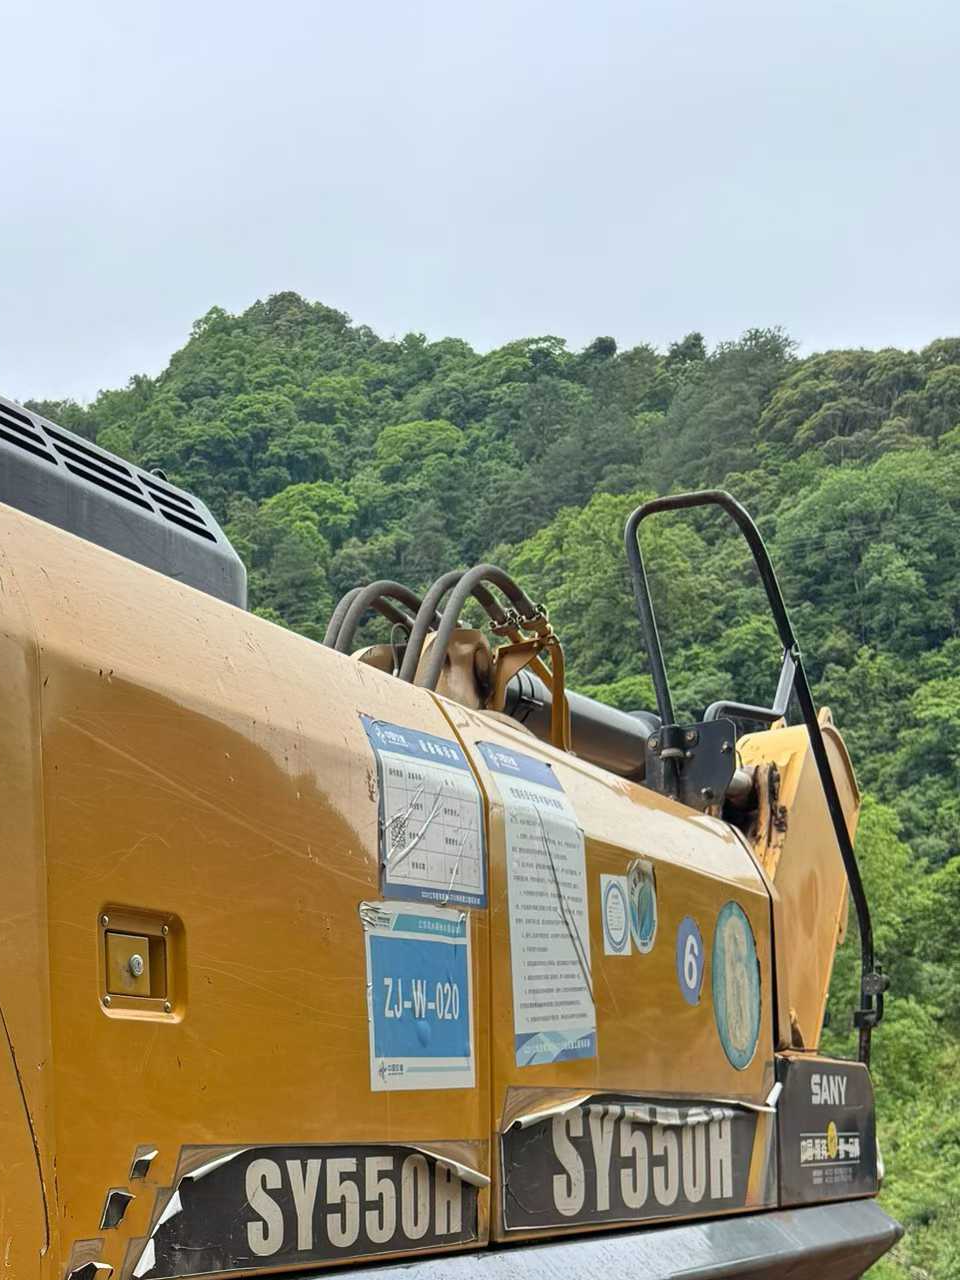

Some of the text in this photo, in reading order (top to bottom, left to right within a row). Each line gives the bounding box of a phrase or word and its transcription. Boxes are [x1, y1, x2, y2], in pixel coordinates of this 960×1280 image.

[683, 933, 700, 990] 6
[383, 977, 460, 1021] ZJ-W-020
[810, 1073, 848, 1106] SANY
[552, 1103, 735, 1217] SY550H
[245, 1153, 463, 1257] SY550H
